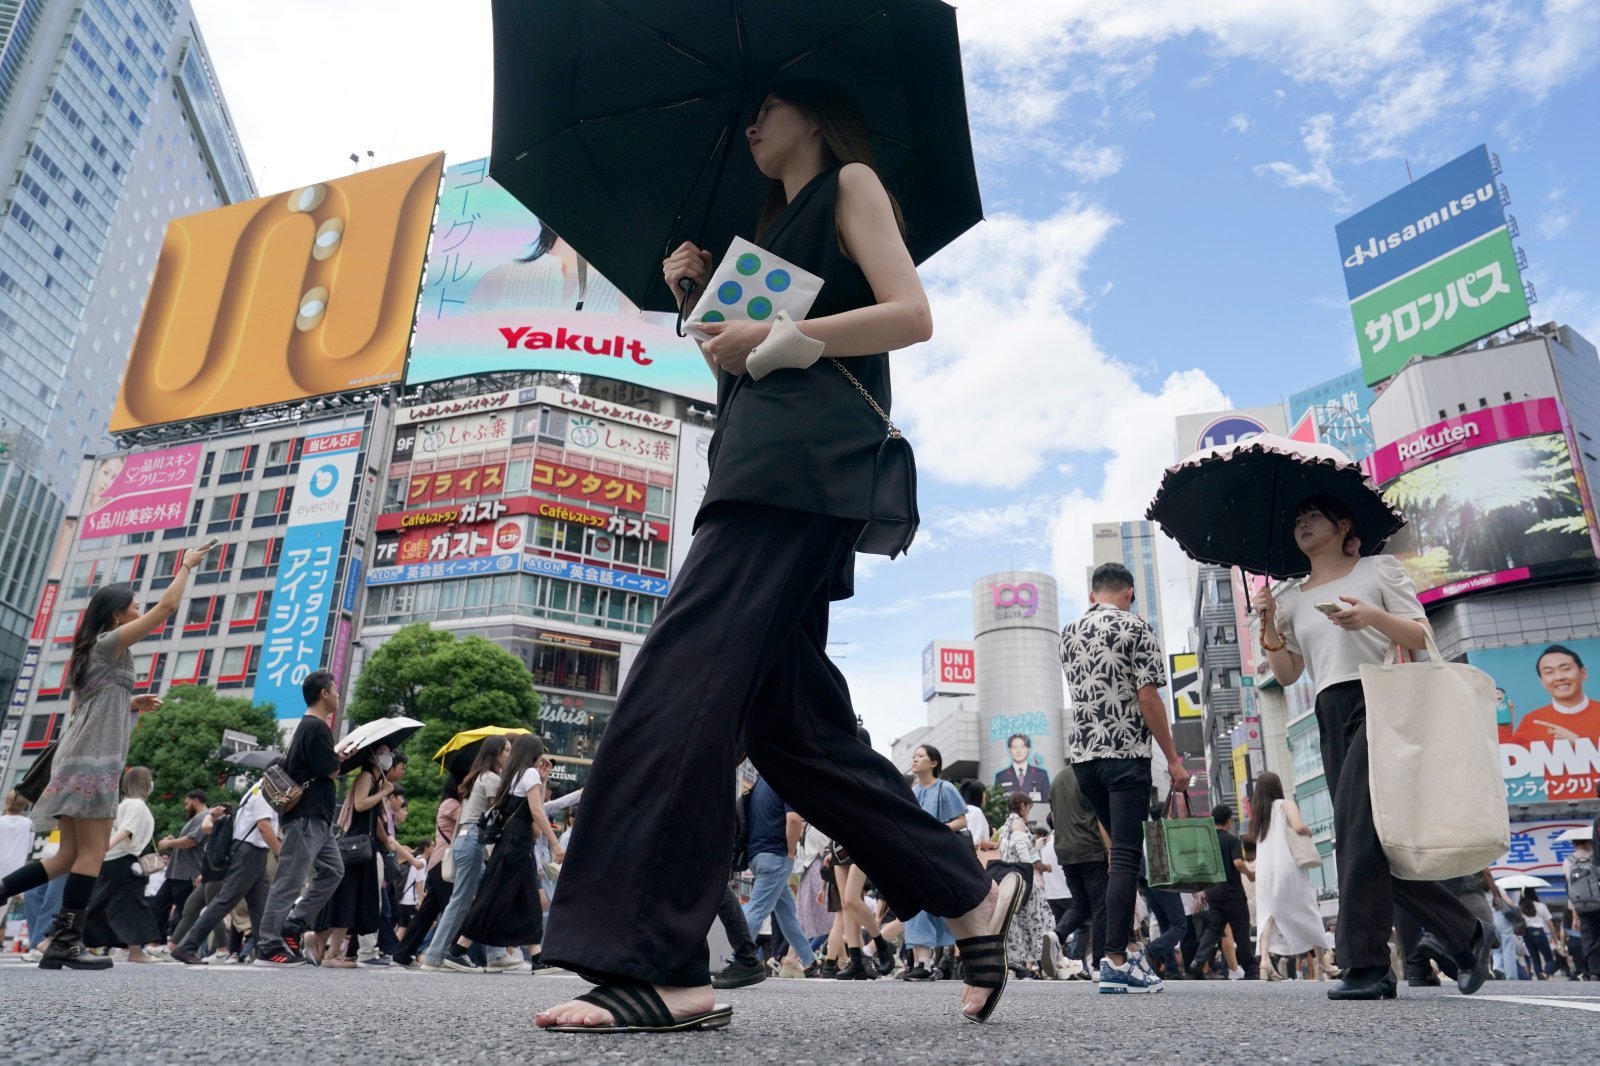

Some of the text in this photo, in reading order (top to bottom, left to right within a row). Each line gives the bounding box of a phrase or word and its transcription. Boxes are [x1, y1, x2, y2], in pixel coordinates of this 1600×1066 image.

[1344, 183, 1493, 268] Hisamitsu
[434, 159, 487, 320] ヨーグルト
[1365, 261, 1510, 353] サロンパス
[498, 326, 653, 366] Yakult
[410, 393, 510, 420] しゃぶしゃぶバイキング
[560, 393, 674, 429] しゃぶしゃぶバイキング
[308, 434, 356, 452] 当ビル5F
[396, 437, 415, 451] 9F
[449, 417, 507, 444] しゃぶ葉
[1398, 421, 1480, 461] Rakuten
[605, 429, 671, 460] しゃぶ葉
[141, 453, 196, 472] 品川スキン
[138, 468, 187, 487] クリニック
[411, 466, 503, 498] プライス
[532, 463, 642, 504] コンタクト
[96, 502, 182, 530] 品川美容外科
[297, 500, 341, 515] eyecity
[459, 500, 507, 524] ガスト
[606, 515, 658, 541] ガスト
[376, 543, 399, 560] 7F
[428, 530, 488, 561] ガスト
[370, 570, 400, 582] AEON
[527, 558, 562, 573] AEON
[988, 582, 1038, 617] 109
[266, 548, 312, 687] アイシティ
[291, 546, 333, 686] コンタクトの
[943, 652, 969, 666] UNI
[943, 667, 972, 681] QLO
[1504, 777, 1600, 798] ンラインクリ
